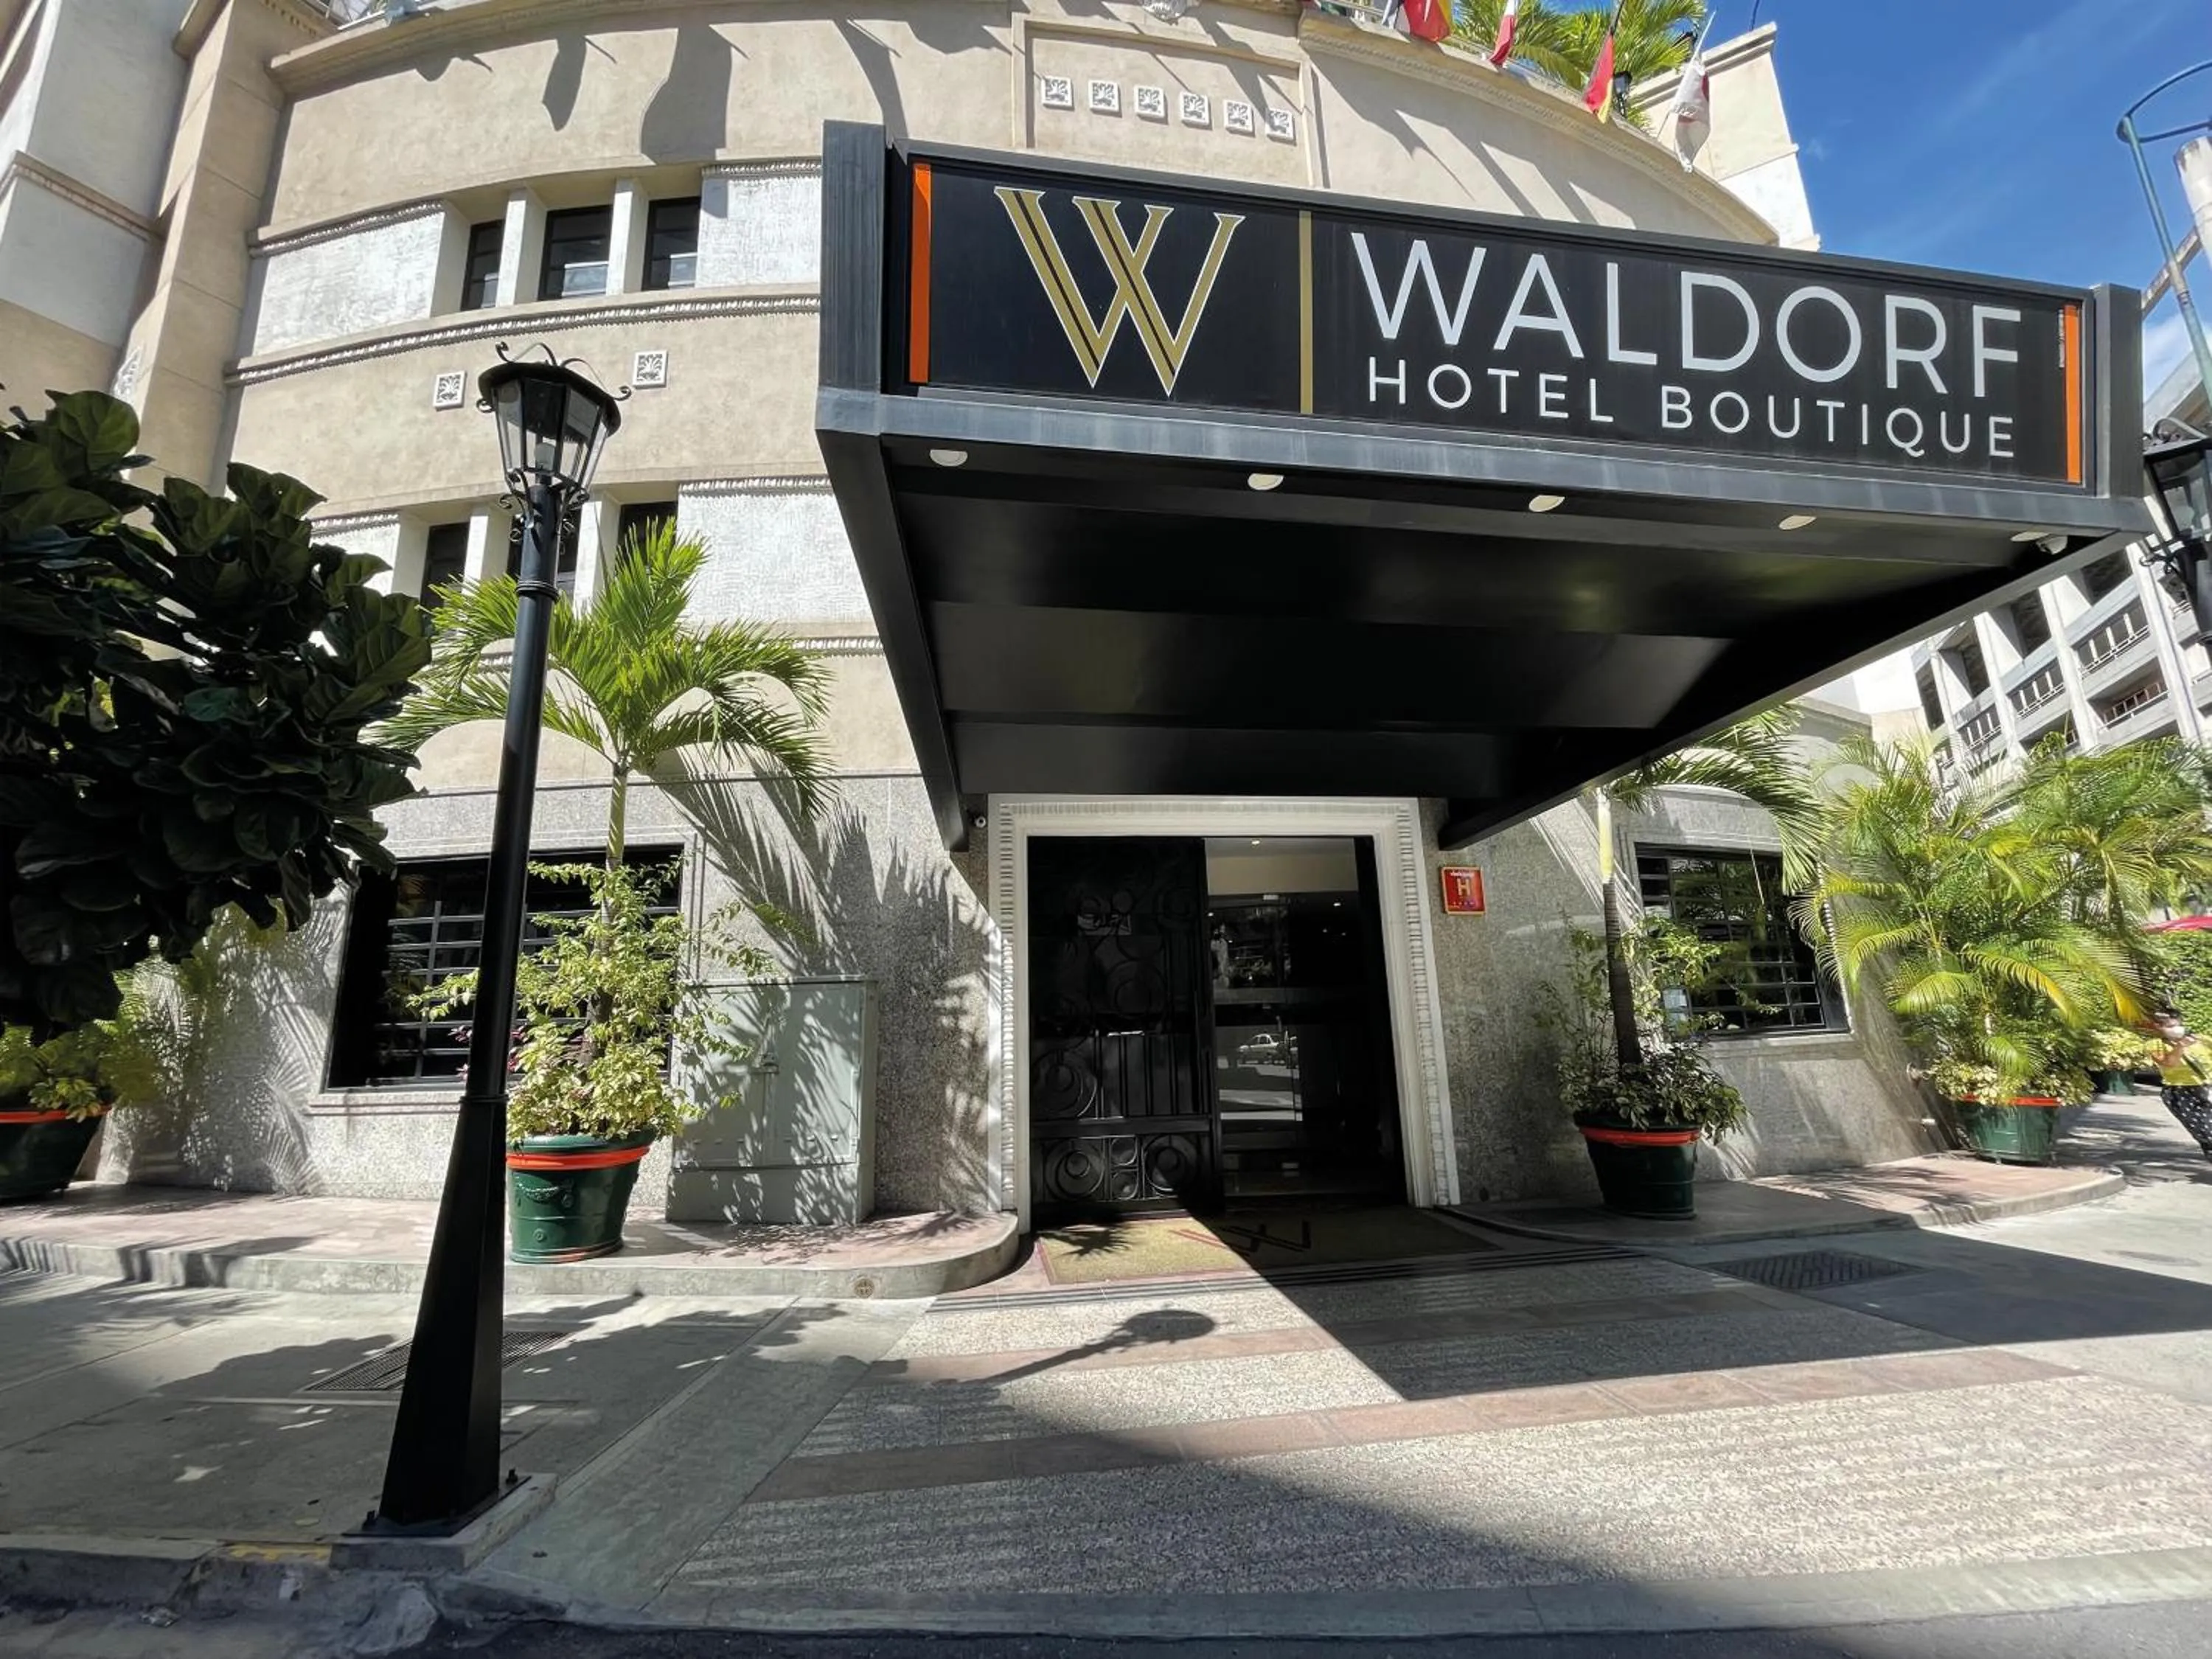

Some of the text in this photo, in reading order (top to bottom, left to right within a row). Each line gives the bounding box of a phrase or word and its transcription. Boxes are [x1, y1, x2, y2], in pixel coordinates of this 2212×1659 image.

[1350, 232, 2021, 397] WALDORF
[1368, 356, 2015, 458] HOTEL BOUTIQUE
[1457, 877, 1471, 896] H
